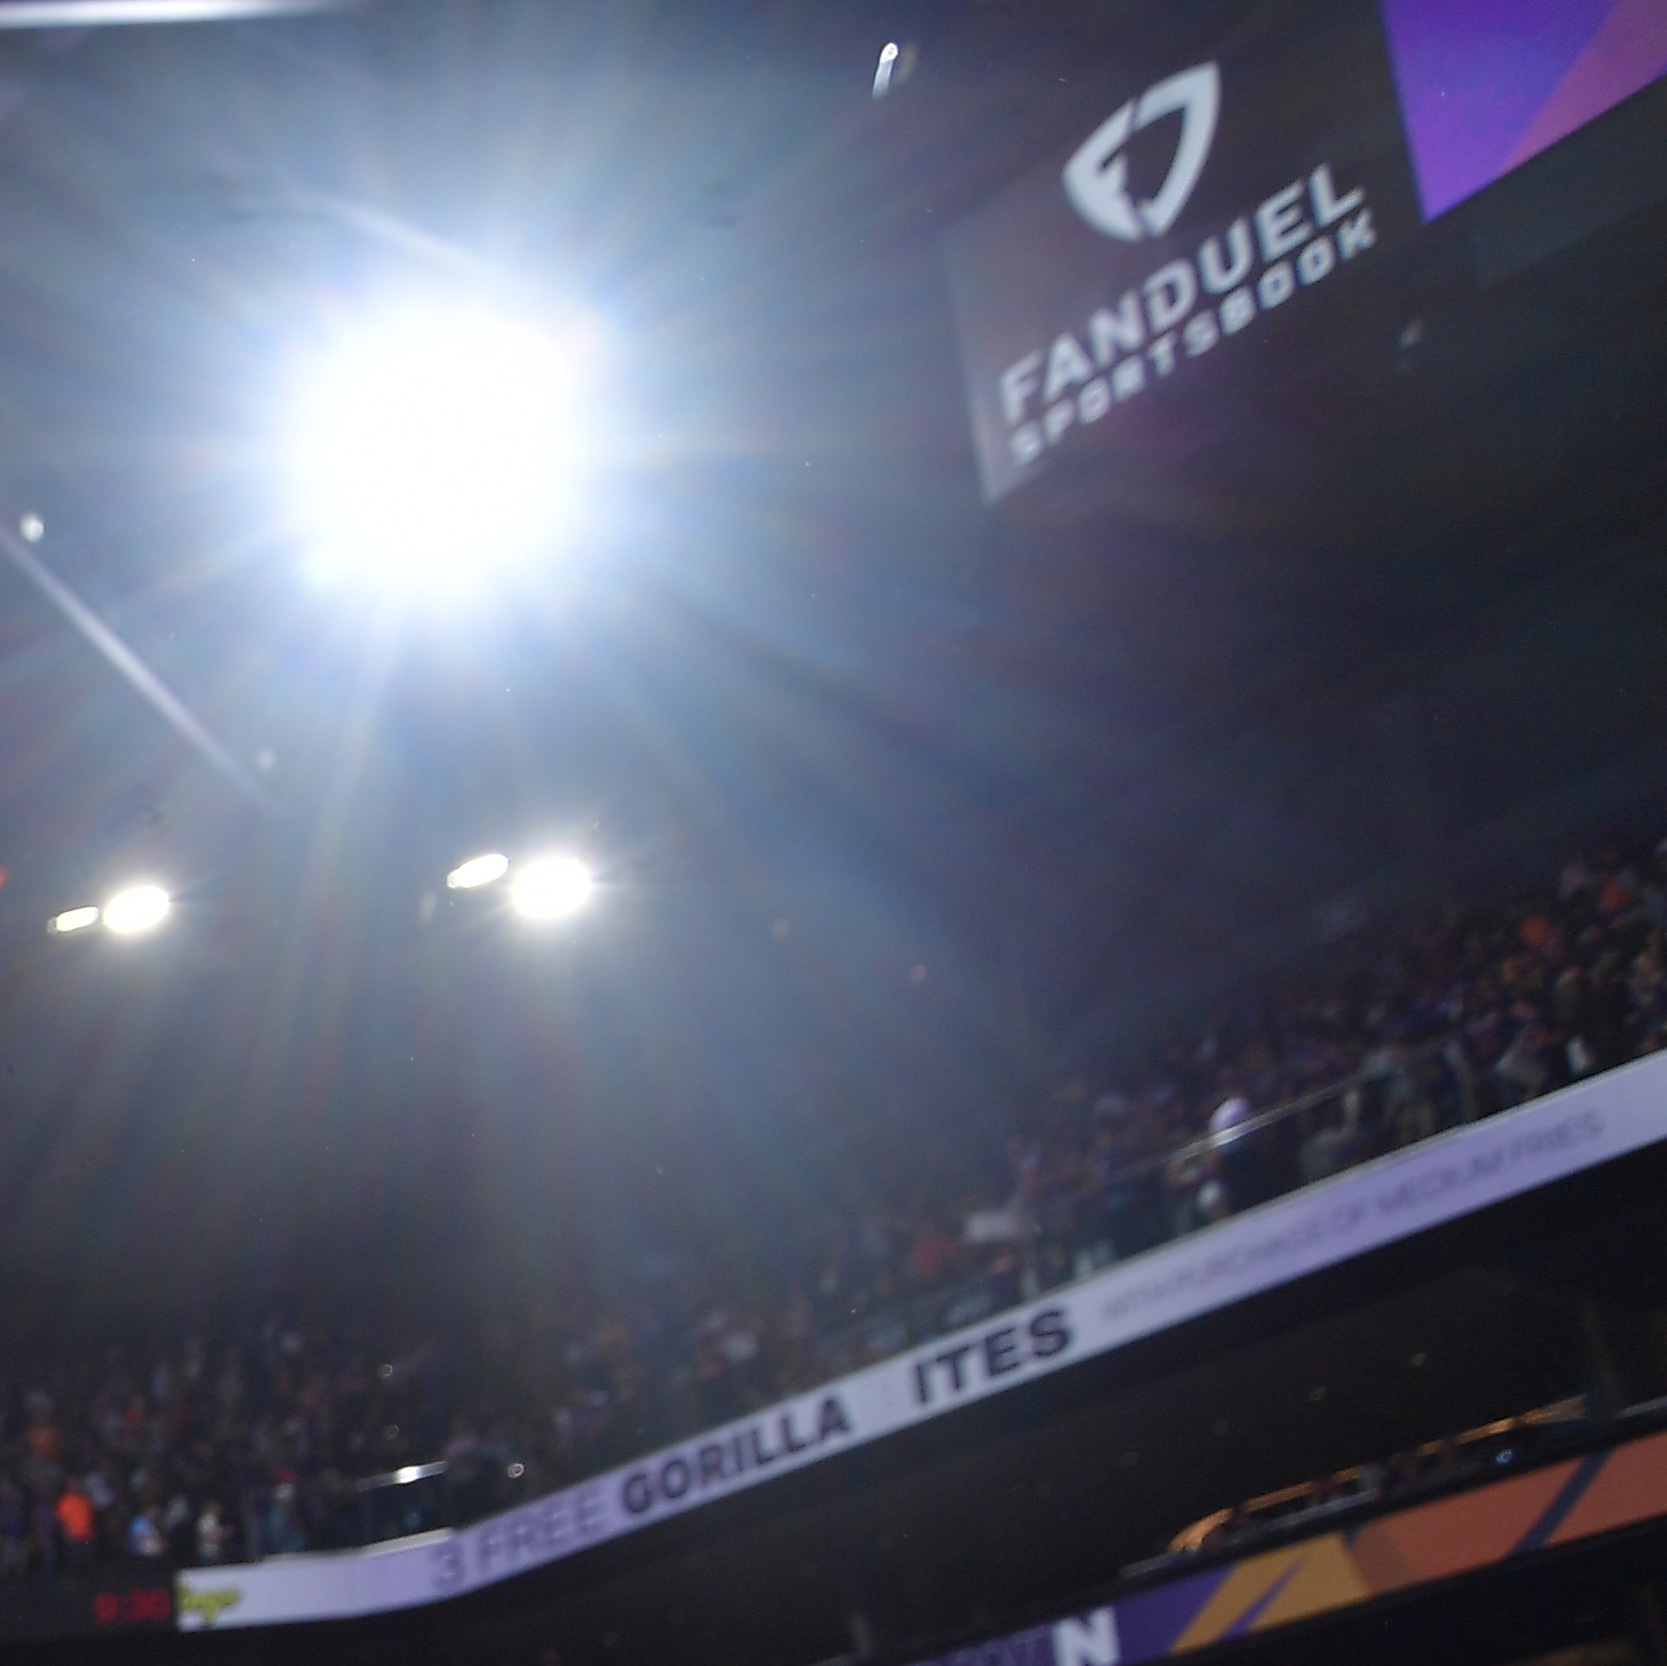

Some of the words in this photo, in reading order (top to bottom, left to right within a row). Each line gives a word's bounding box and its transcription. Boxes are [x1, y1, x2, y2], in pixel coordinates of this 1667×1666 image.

[998, 162, 1364, 425] FANDUEL
[1009, 208, 1378, 467] SPORTSBOOK
[476, 1494, 610, 1572] FREE
[620, 1396, 852, 1514] GORILLA
[913, 1307, 1077, 1405] ITES
